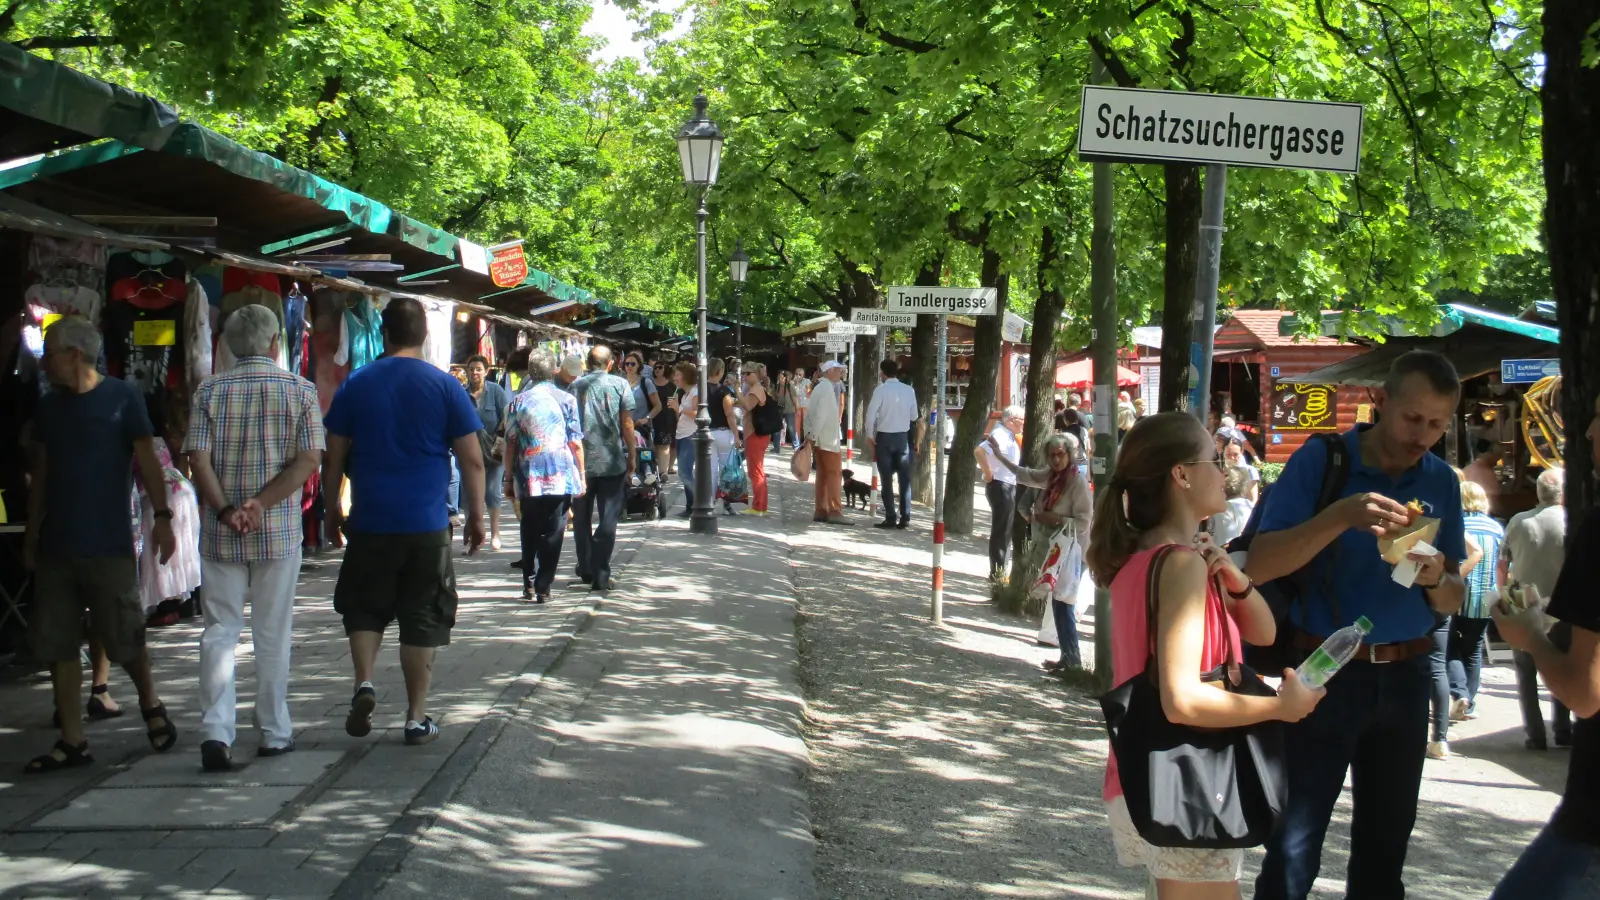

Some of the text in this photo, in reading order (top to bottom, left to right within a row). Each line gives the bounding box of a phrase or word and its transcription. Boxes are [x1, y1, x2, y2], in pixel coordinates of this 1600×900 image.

[1096, 102, 1344, 161] Schatzsuchergasse
[898, 292, 987, 312] Tandlergasse
[856, 311, 911, 324] Raritätengasse
